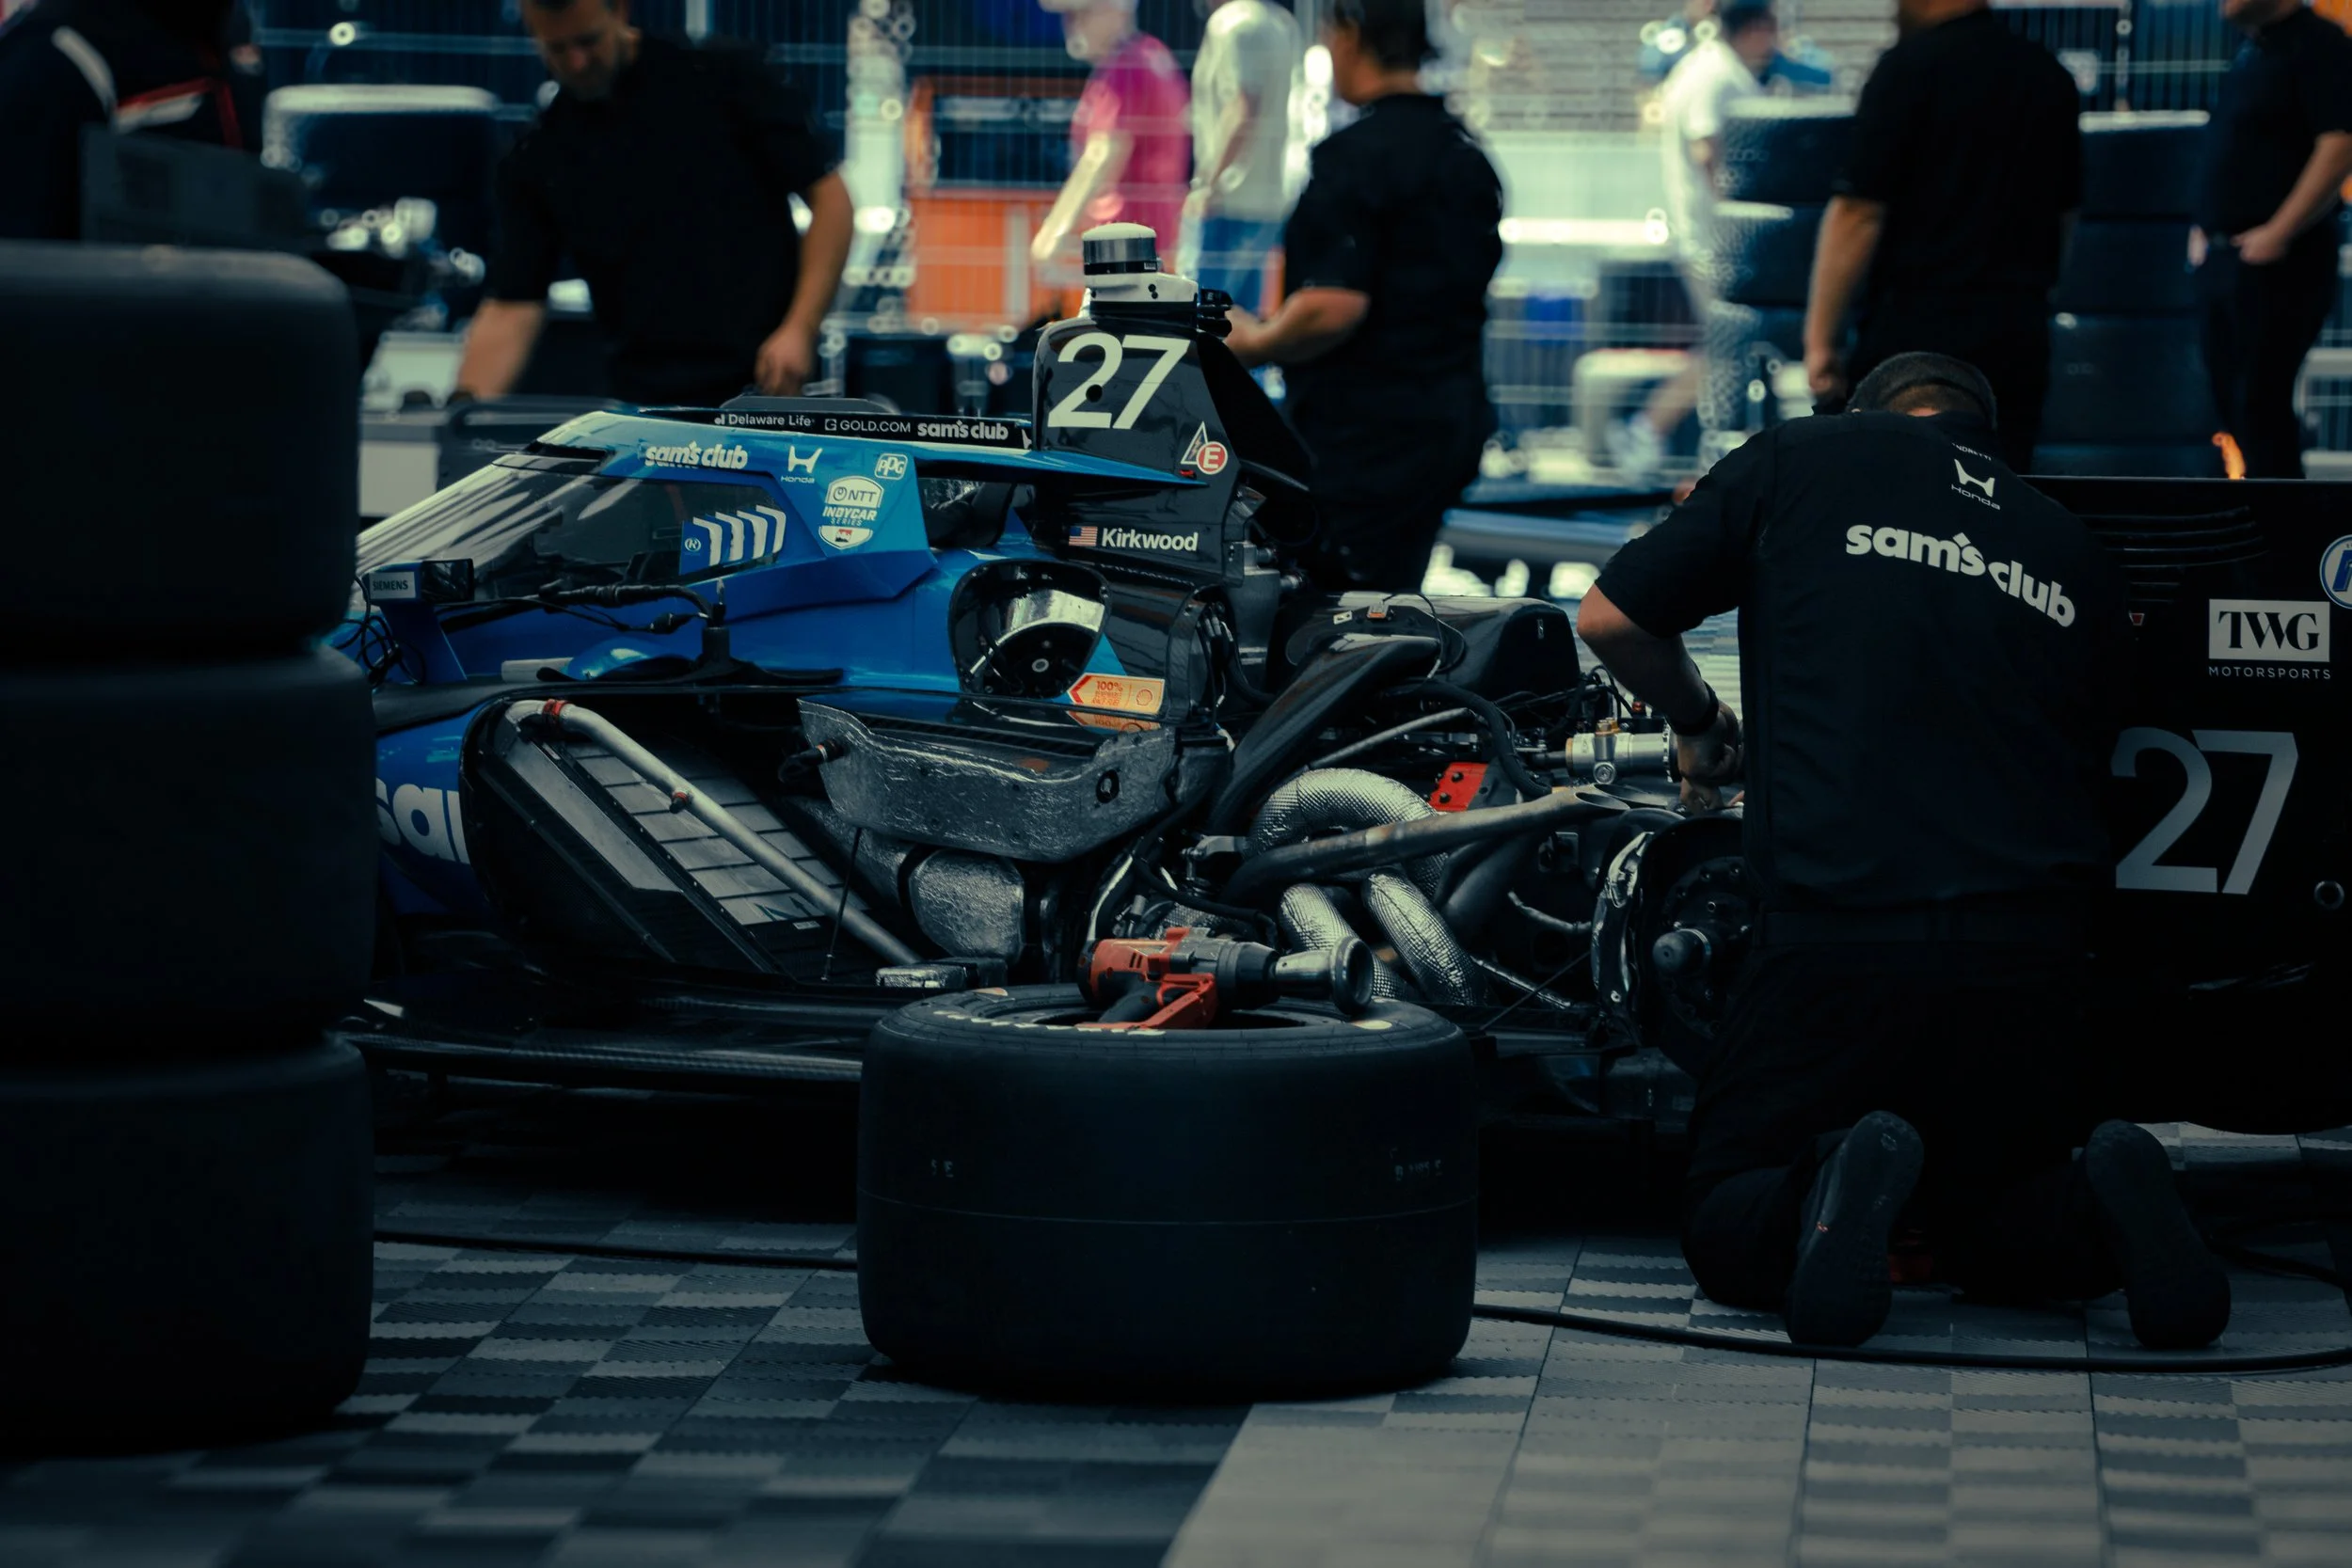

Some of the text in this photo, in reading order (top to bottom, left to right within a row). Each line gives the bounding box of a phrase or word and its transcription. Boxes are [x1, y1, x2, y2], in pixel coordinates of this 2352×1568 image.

[1047, 332, 1192, 430] 27
[728, 413, 785, 425] Delaware
[839, 420, 912, 434] GOLD.COM
[917, 420, 1009, 440] sam's club
[644, 440, 749, 469] sam's club
[1202, 446, 1222, 468] E
[879, 456, 905, 477] PPG
[849, 489, 877, 502] NTT
[822, 505, 878, 521] INDYCAR
[830, 517, 864, 527] SERIES
[1101, 527, 1199, 552] Kirkwood
[373, 579, 408, 591] SIEMENS
[1846, 524, 2076, 628] sam's club
[2218, 610, 2320, 651] TWG
[2208, 666, 2332, 680] MOTORSPORTS
[1097, 680, 1123, 692] 100%
[2110, 726, 2299, 895] 27
